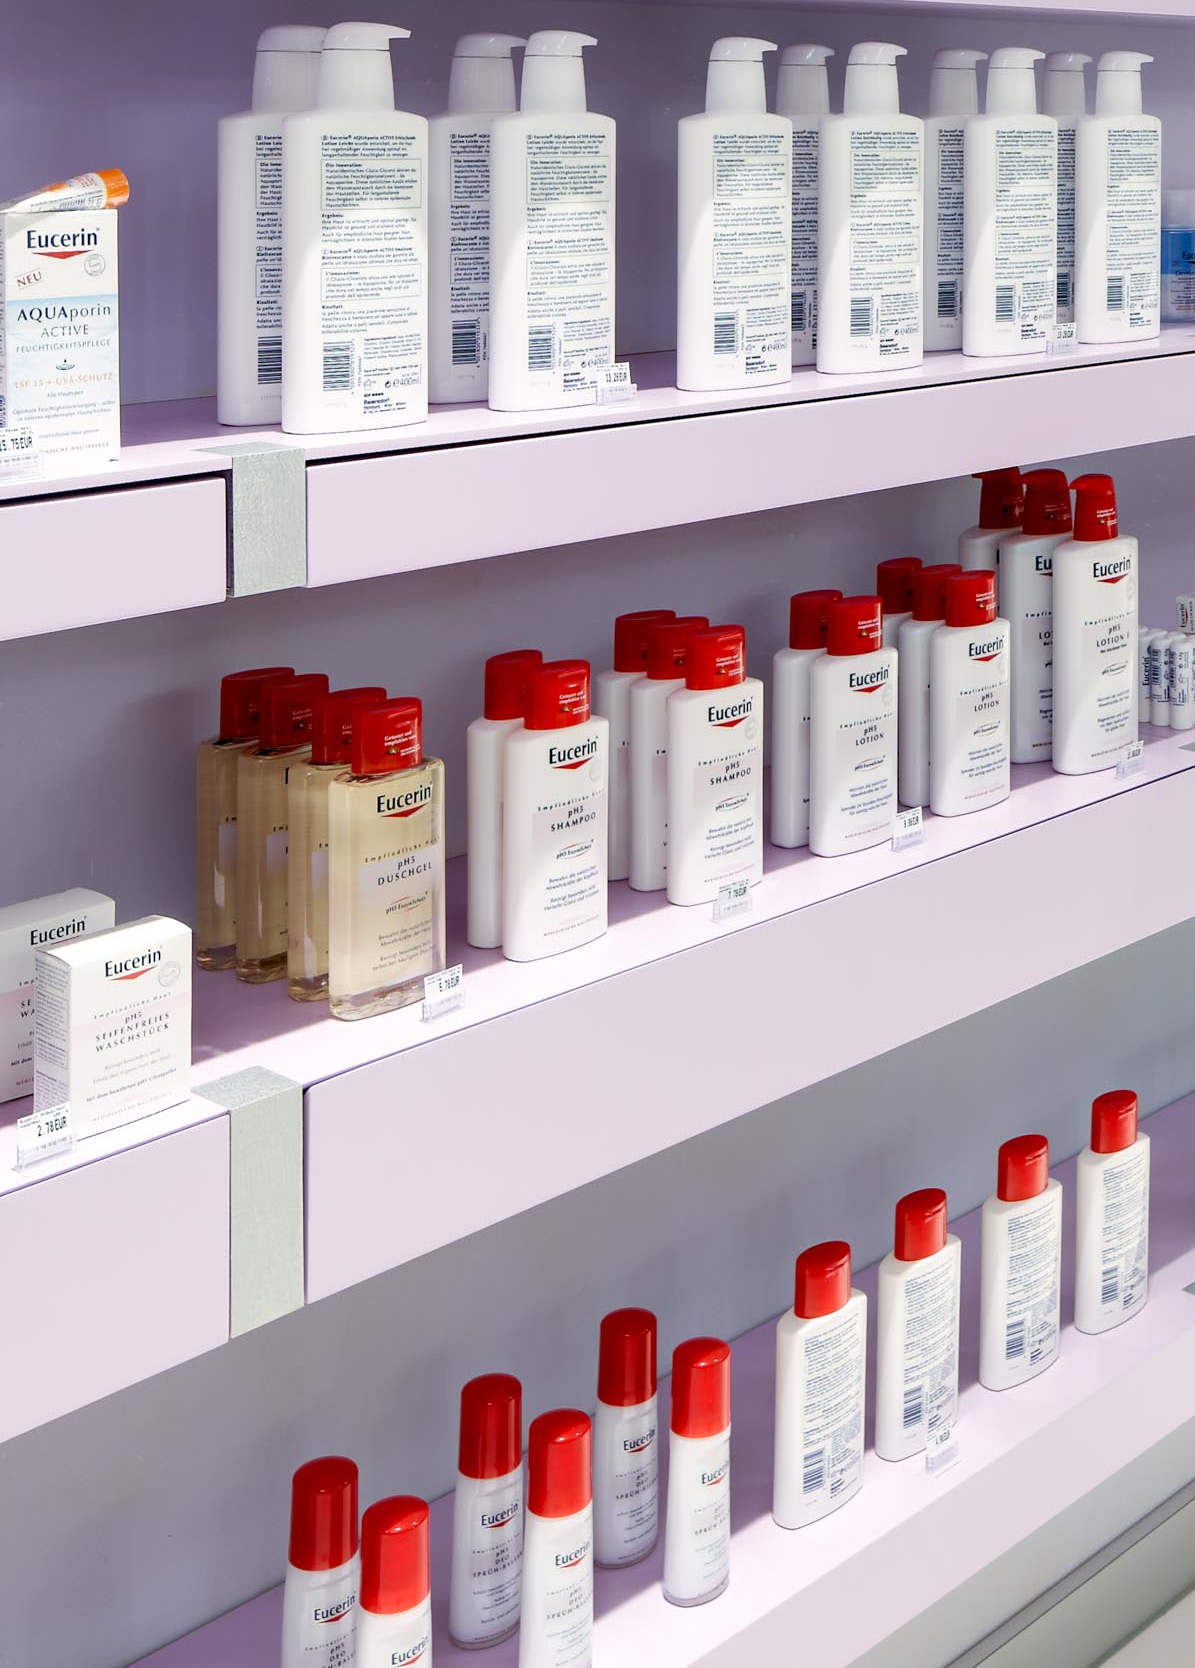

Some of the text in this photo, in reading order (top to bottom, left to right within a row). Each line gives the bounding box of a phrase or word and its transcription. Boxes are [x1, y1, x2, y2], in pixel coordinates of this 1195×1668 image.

[27, 228, 98, 249] Eucerin
[17, 271, 43, 288] NEU
[17, 303, 111, 323] AQUAporin
[41, 324, 89, 338] ACTIVE
[16, 339, 111, 353] FEUCHTIGKEITSPFLEGE
[56, 372, 113, 386] UVA-SCHUTZ
[1093, 557, 1131, 578] Eucerin
[969, 636, 1005, 657] Eucerin
[1096, 635, 1124, 648] LOTION
[849, 667, 889, 688] Eucerin
[708, 698, 752, 723] Eucerin
[974, 700, 999, 712] LOTION
[855, 734, 884, 746] LOTION
[549, 739, 597, 764] Eucerin
[710, 768, 752, 785] SHAMPOO
[725, 761, 740, 773] pH5
[377, 784, 432, 813] Eucerin
[551, 812, 596, 832] SHAMPOO
[568, 806, 584, 818] pH5
[397, 856, 416, 871] pH5
[377, 863, 432, 886] DUSCHGEL
[30, 917, 86, 946] Eucerin
[104, 948, 161, 977] Eucerin
[95, 1013, 170, 1043] SEIFENFREIES
[125, 1012, 142, 1023] pH5
[95, 1023, 169, 1052] WASCHSTÜCK
[481, 1502, 519, 1526] Eucerin
[555, 1541, 590, 1566] Eucerin
[314, 1595, 355, 1621] Eucerin
[391, 1636, 429, 1665] Eucerin
